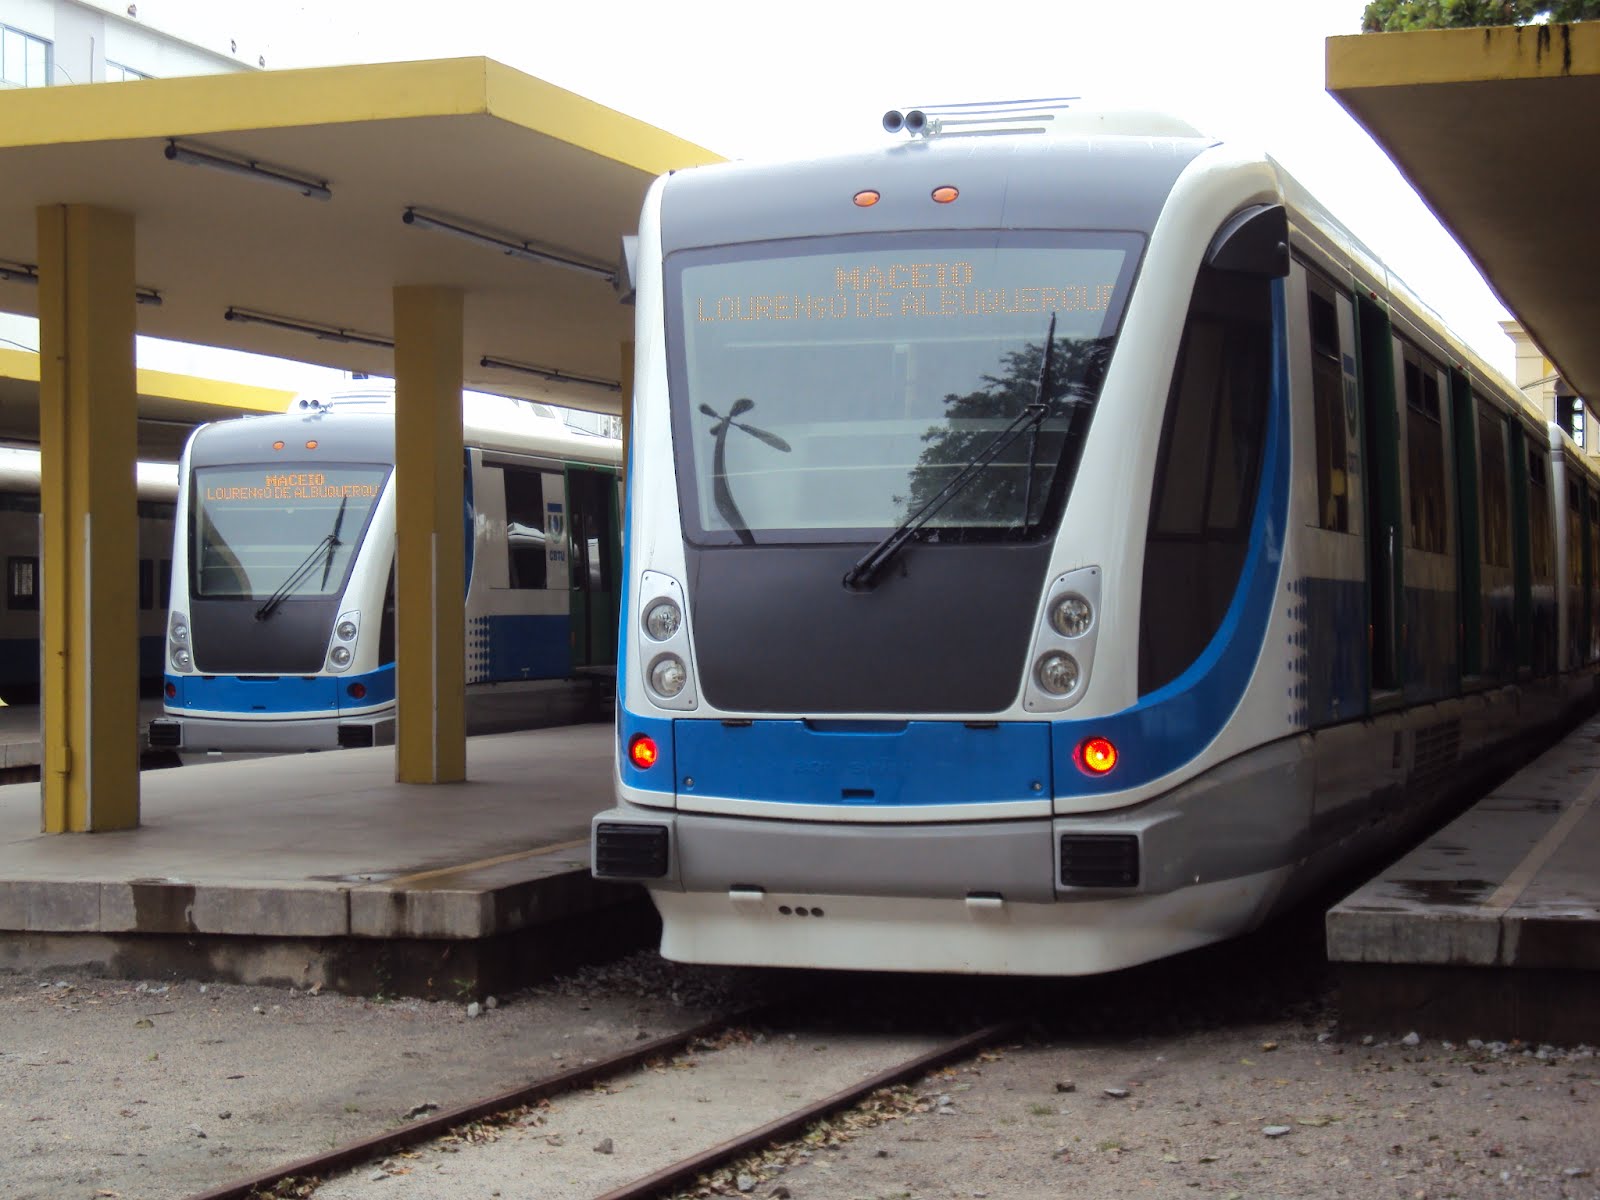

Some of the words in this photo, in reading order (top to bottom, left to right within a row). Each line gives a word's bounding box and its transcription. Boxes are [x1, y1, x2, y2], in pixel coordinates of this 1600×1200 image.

[836, 261, 972, 291] MACEIO
[856, 292, 894, 318] DE
[265, 473, 325, 487] MACEIO
[274, 487, 292, 499] DE
[294, 485, 380, 499] ALBUQUERQU
